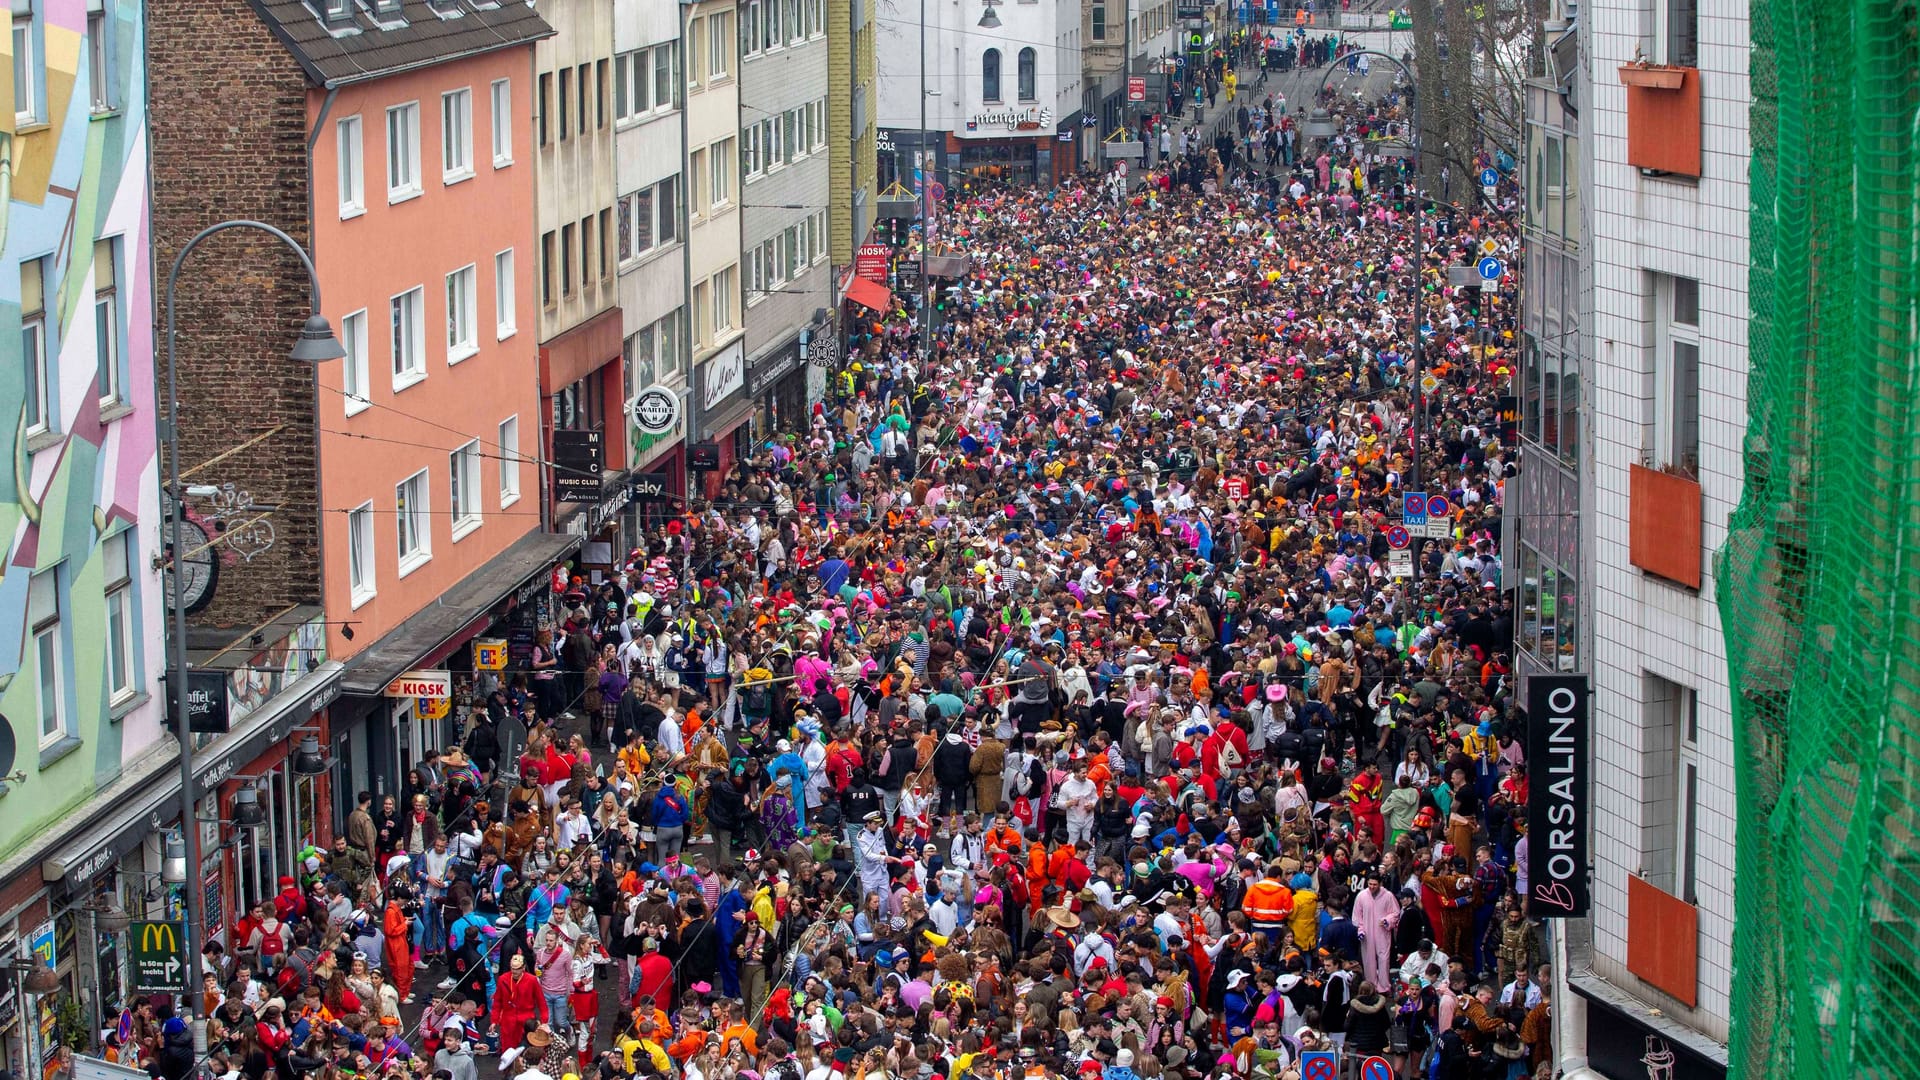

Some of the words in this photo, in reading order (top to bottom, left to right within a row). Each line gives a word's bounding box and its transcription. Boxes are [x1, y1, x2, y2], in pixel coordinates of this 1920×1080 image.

[974, 108, 1031, 131] mangal
[857, 247, 885, 256] KIOSK
[558, 478, 580, 486] MUSIC
[636, 480, 662, 497] sky
[1405, 515, 1425, 525] TAXI
[403, 682, 445, 695] KIOSK
[187, 690, 210, 703] affel
[1535, 687, 1576, 911] BORSALINO
[1350, 874, 1366, 893] 84
